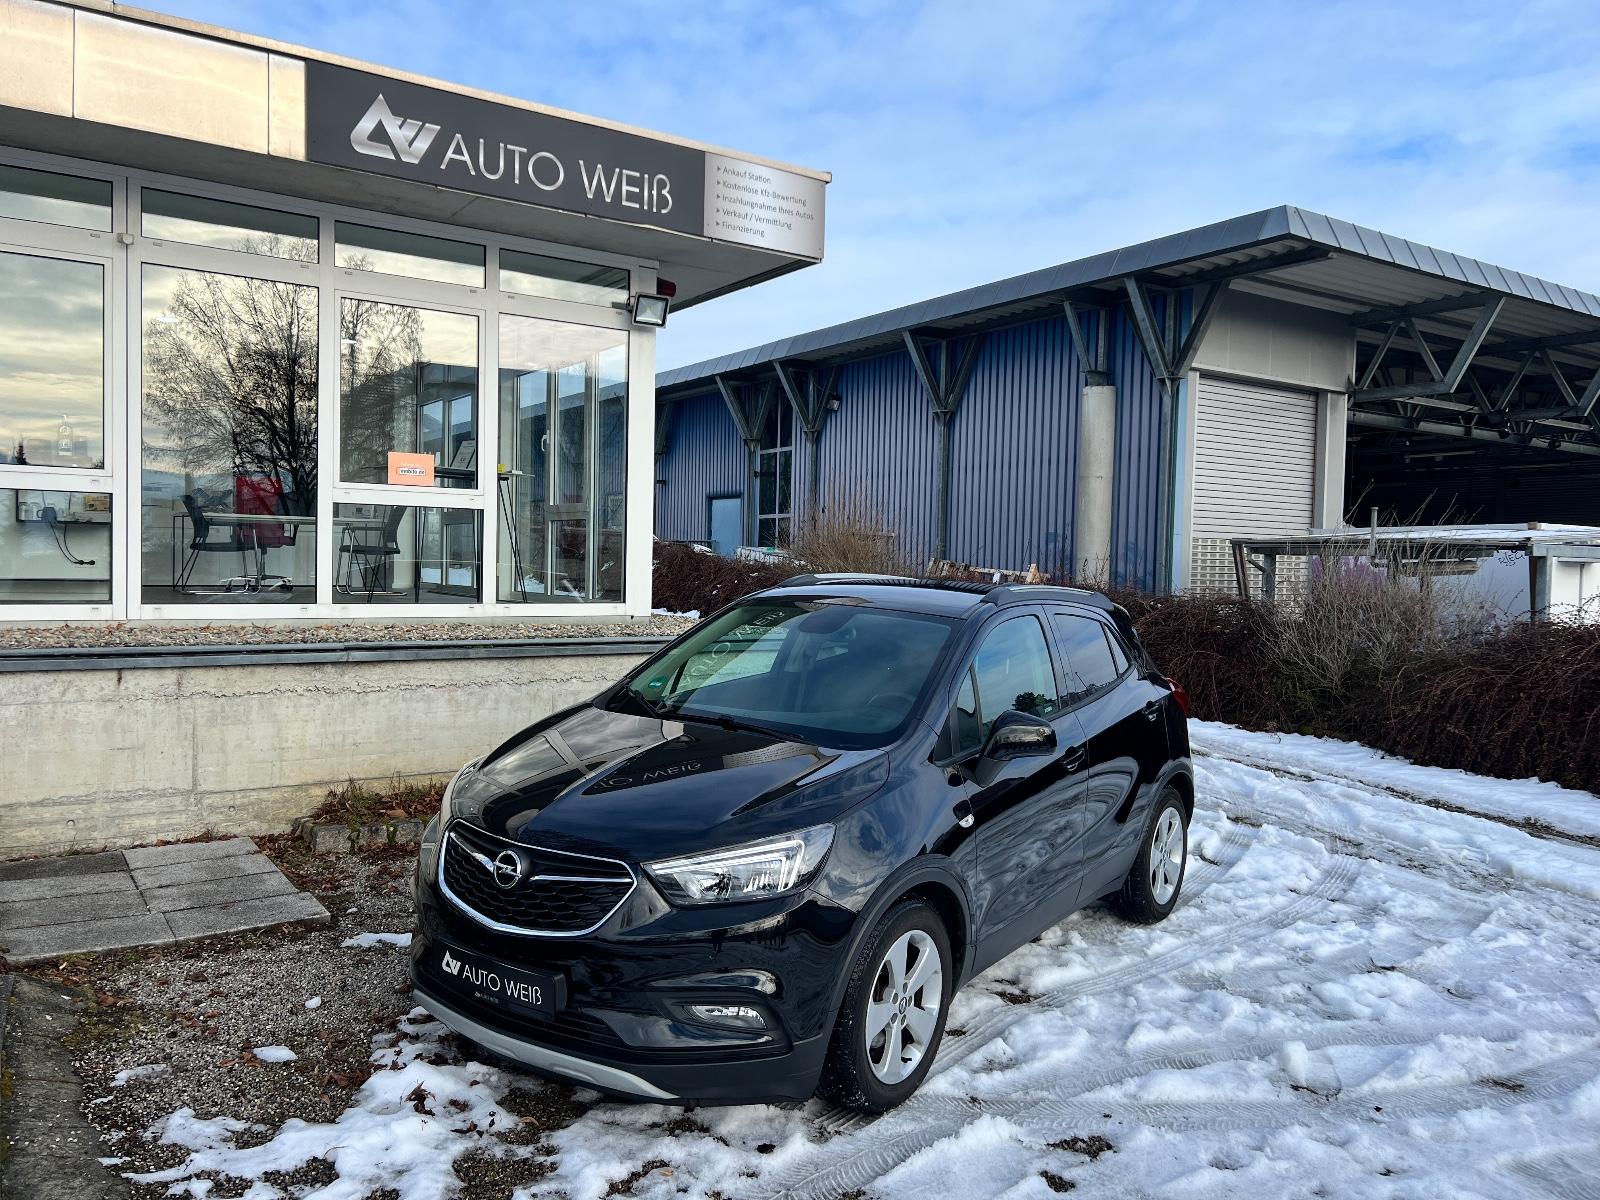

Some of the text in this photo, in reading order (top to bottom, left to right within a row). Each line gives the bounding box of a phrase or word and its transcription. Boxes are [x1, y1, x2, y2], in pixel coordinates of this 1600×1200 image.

[439, 133, 565, 191] AUTO
[578, 159, 673, 214] WEIß
[722, 165, 772, 184] Ankauf Station
[722, 180, 759, 195] Kostenlose
[722, 194, 777, 213] Inzahlungnahme
[722, 208, 748, 220] Verkauf
[754, 214, 792, 231] Vermittlung
[721, 221, 765, 238] Finanzierung
[462, 964, 500, 991] AUTO
